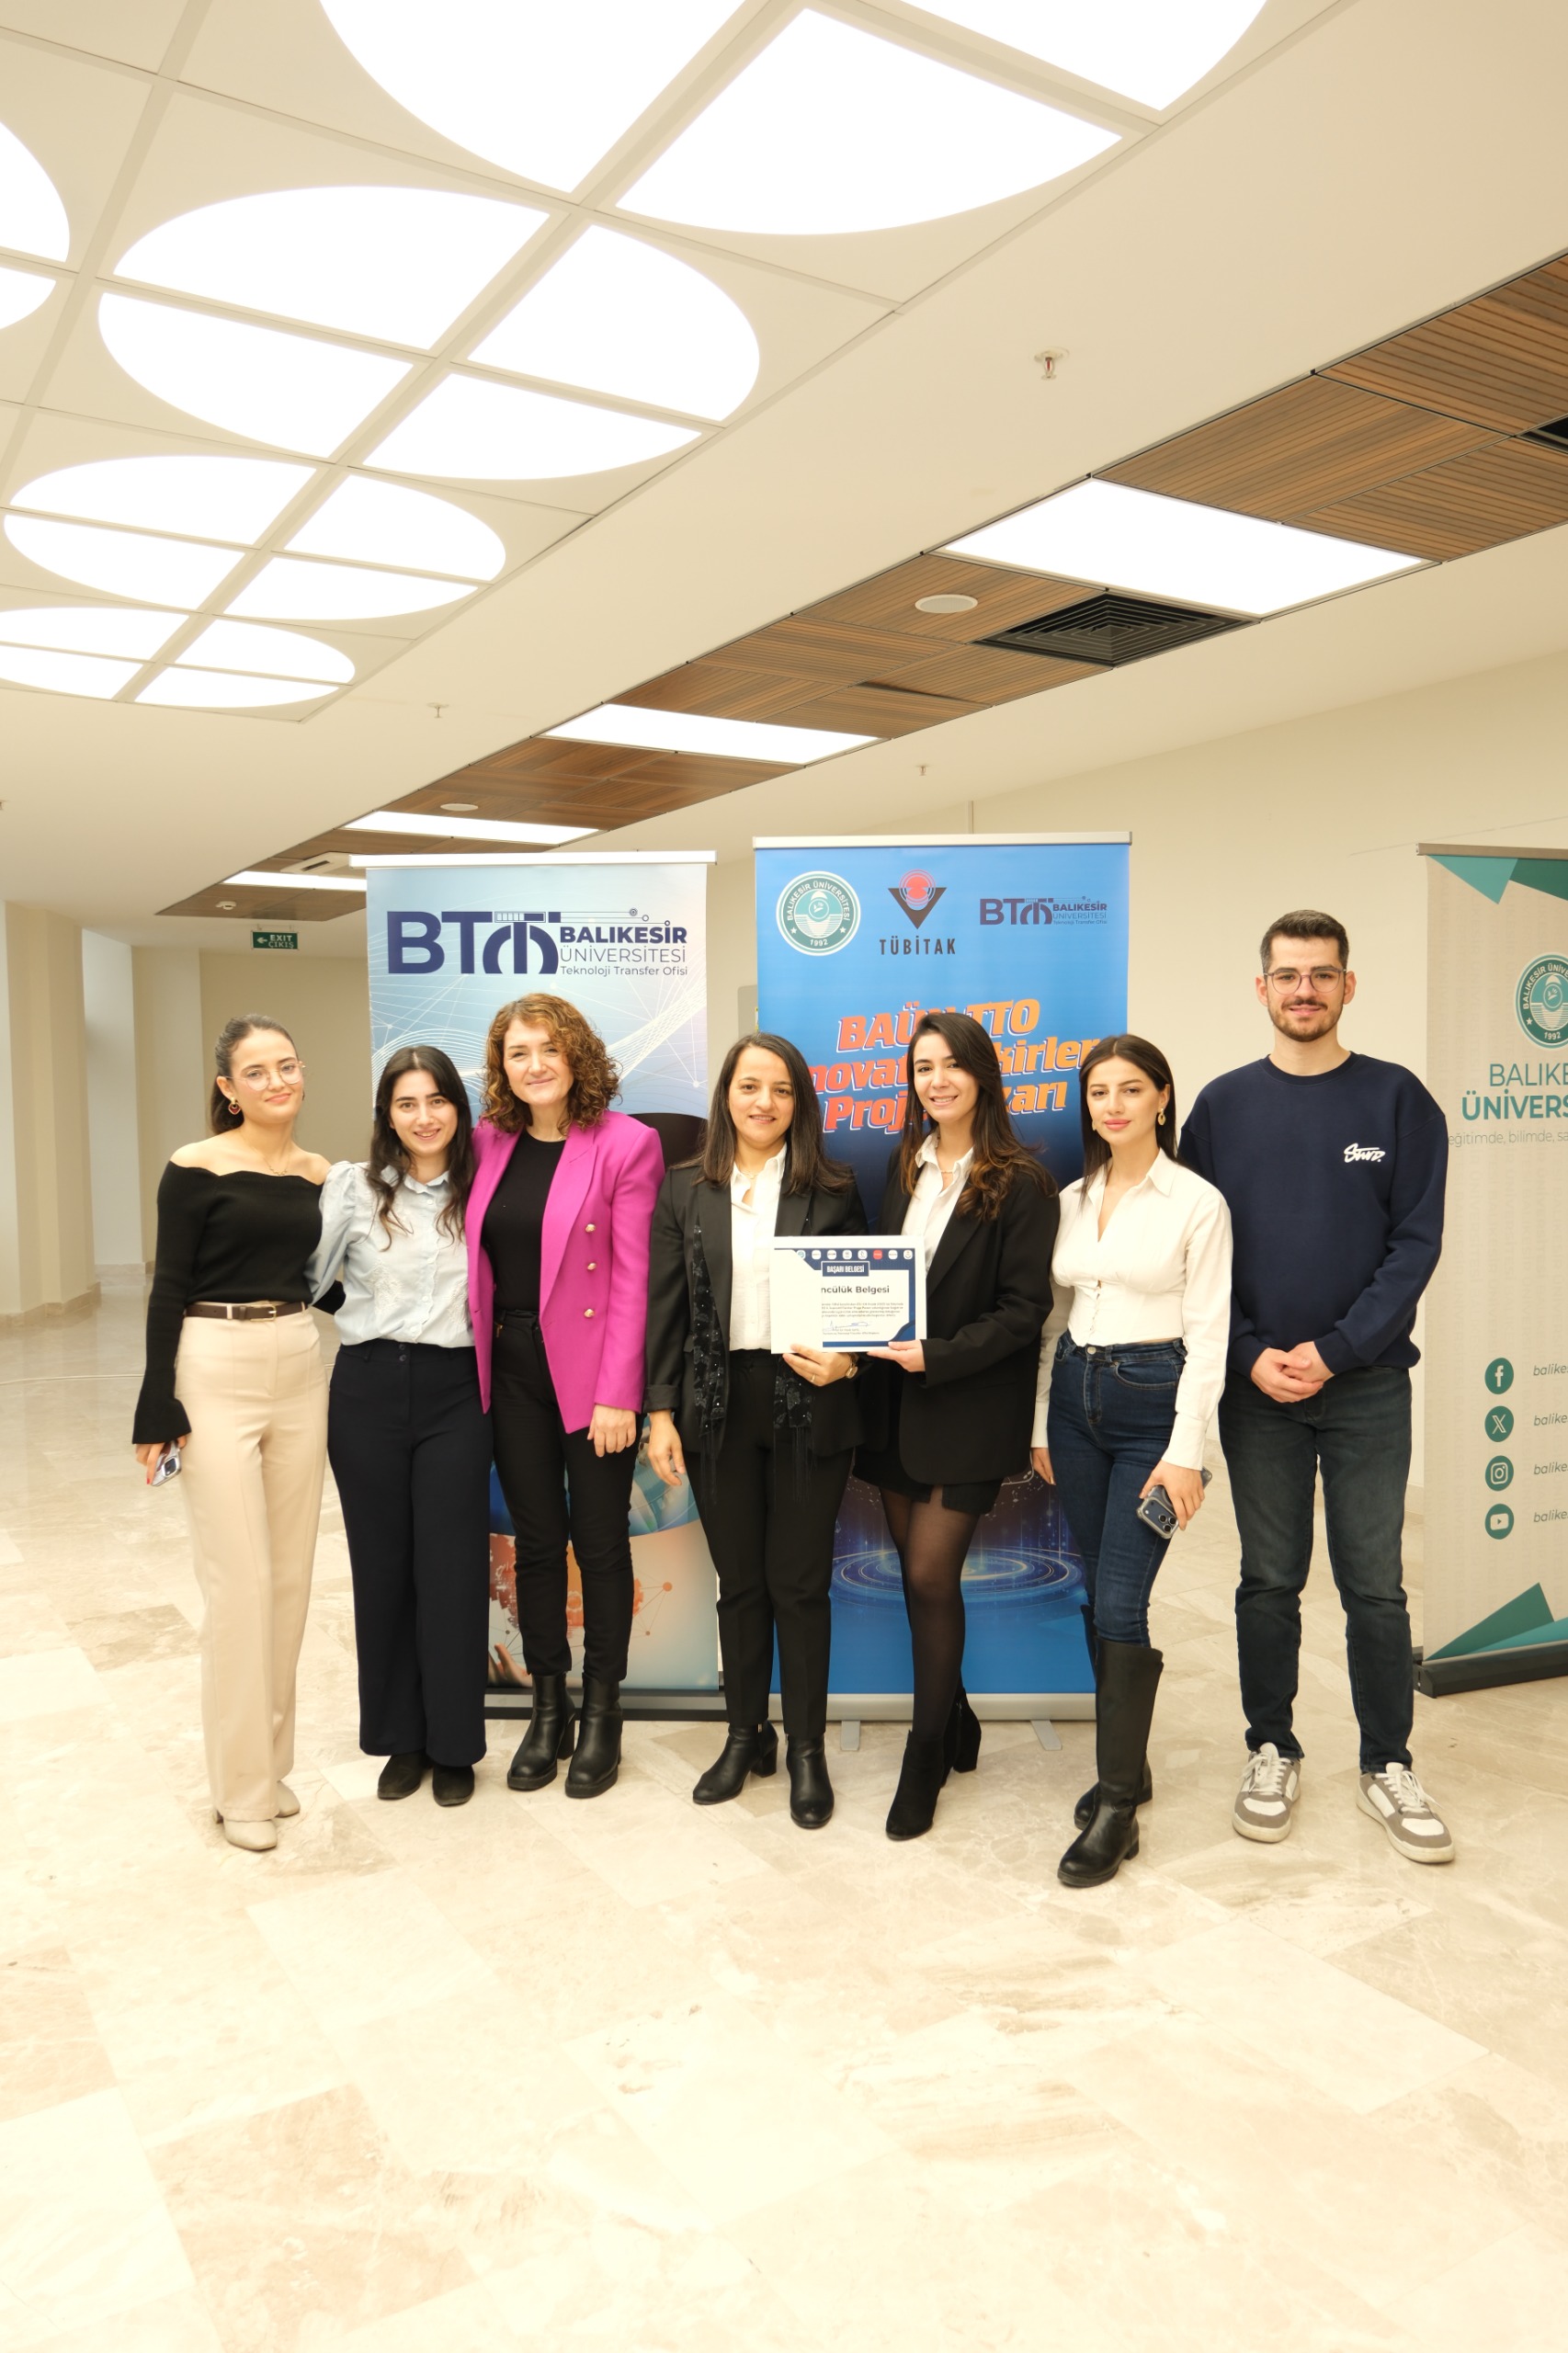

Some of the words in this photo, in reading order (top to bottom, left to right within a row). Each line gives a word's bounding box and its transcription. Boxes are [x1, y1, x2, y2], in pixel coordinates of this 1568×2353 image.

[786, 882, 812, 921] BALIKESİR
[1052, 901, 1108, 912] BALIKESİR
[1052, 911, 1108, 920] ÜNİVERSİTESİ
[269, 934, 293, 942] EXIT
[560, 921, 687, 944] BALIKESİR
[810, 938, 829, 947] 1992
[879, 935, 956, 956] TÜBİTAK
[560, 945, 687, 963] ÜNİVERSİTESİ
[560, 965, 611, 977] Teknoloji
[613, 966, 660, 976] Transfer
[663, 966, 688, 976] Ofisi
[1522, 965, 1547, 1010] BALIKESİR
[836, 1000, 957, 1053] BAÜ
[1544, 1031, 1562, 1040] 1992
[823, 1089, 910, 1135] Proj
[1508, 1129, 1555, 1144] bilimde,
[855, 1285, 890, 1295] Belgesi
[1532, 1363, 1568, 1377] balike
[1532, 1413, 1568, 1427] balike
[1532, 1461, 1568, 1475] balike
[1532, 1509, 1568, 1523] balike
